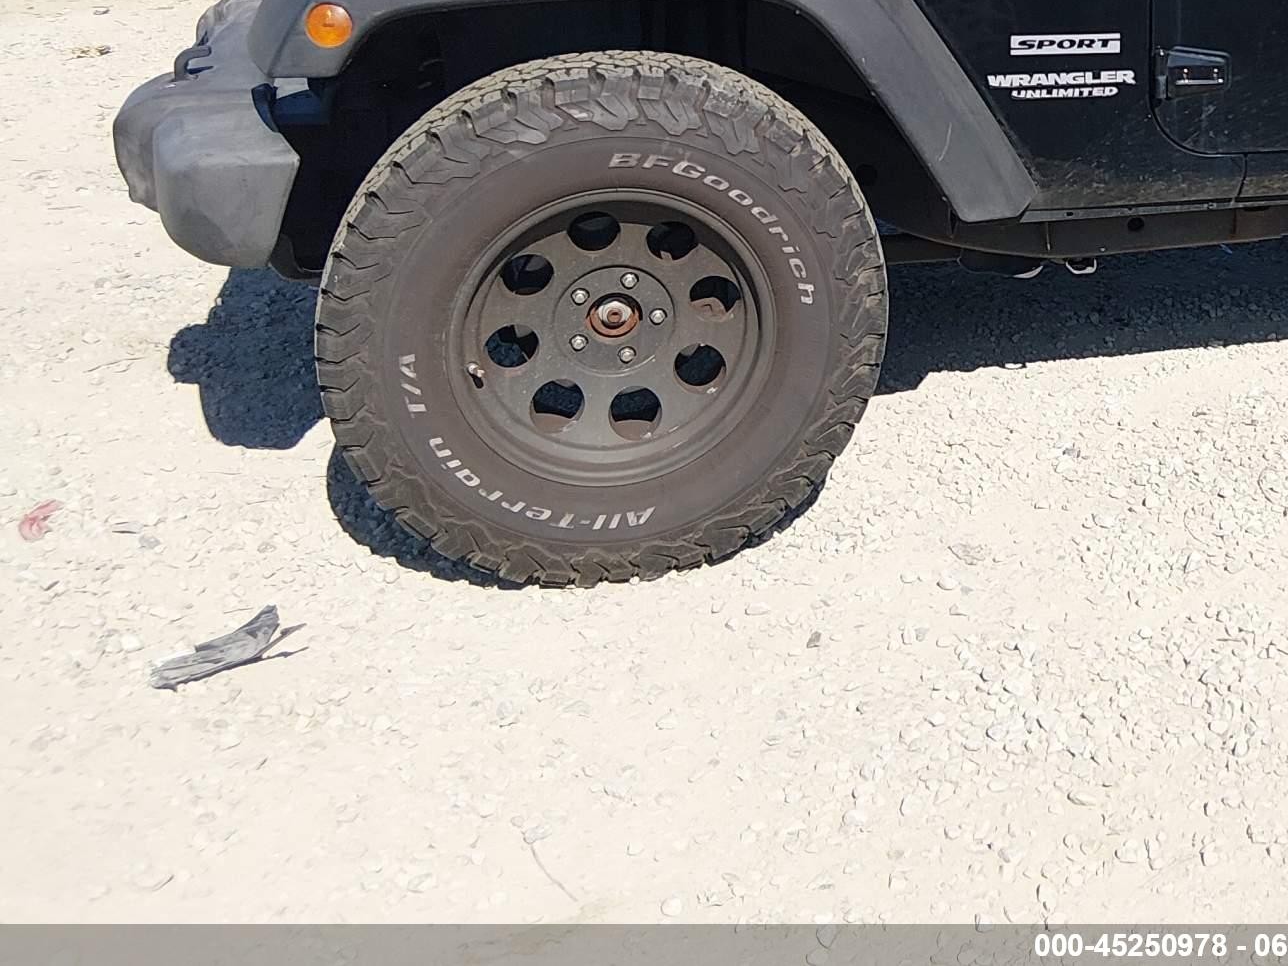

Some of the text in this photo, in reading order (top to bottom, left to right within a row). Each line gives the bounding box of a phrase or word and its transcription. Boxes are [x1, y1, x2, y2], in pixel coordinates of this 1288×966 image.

[1017, 37, 1116, 50] SPORT
[987, 70, 1136, 87] WRANGLER
[1011, 86, 1119, 99] UNLIMITED
[608, 153, 815, 305] BFGoodrich
[399, 353, 656, 529] All-Terrain T/A
